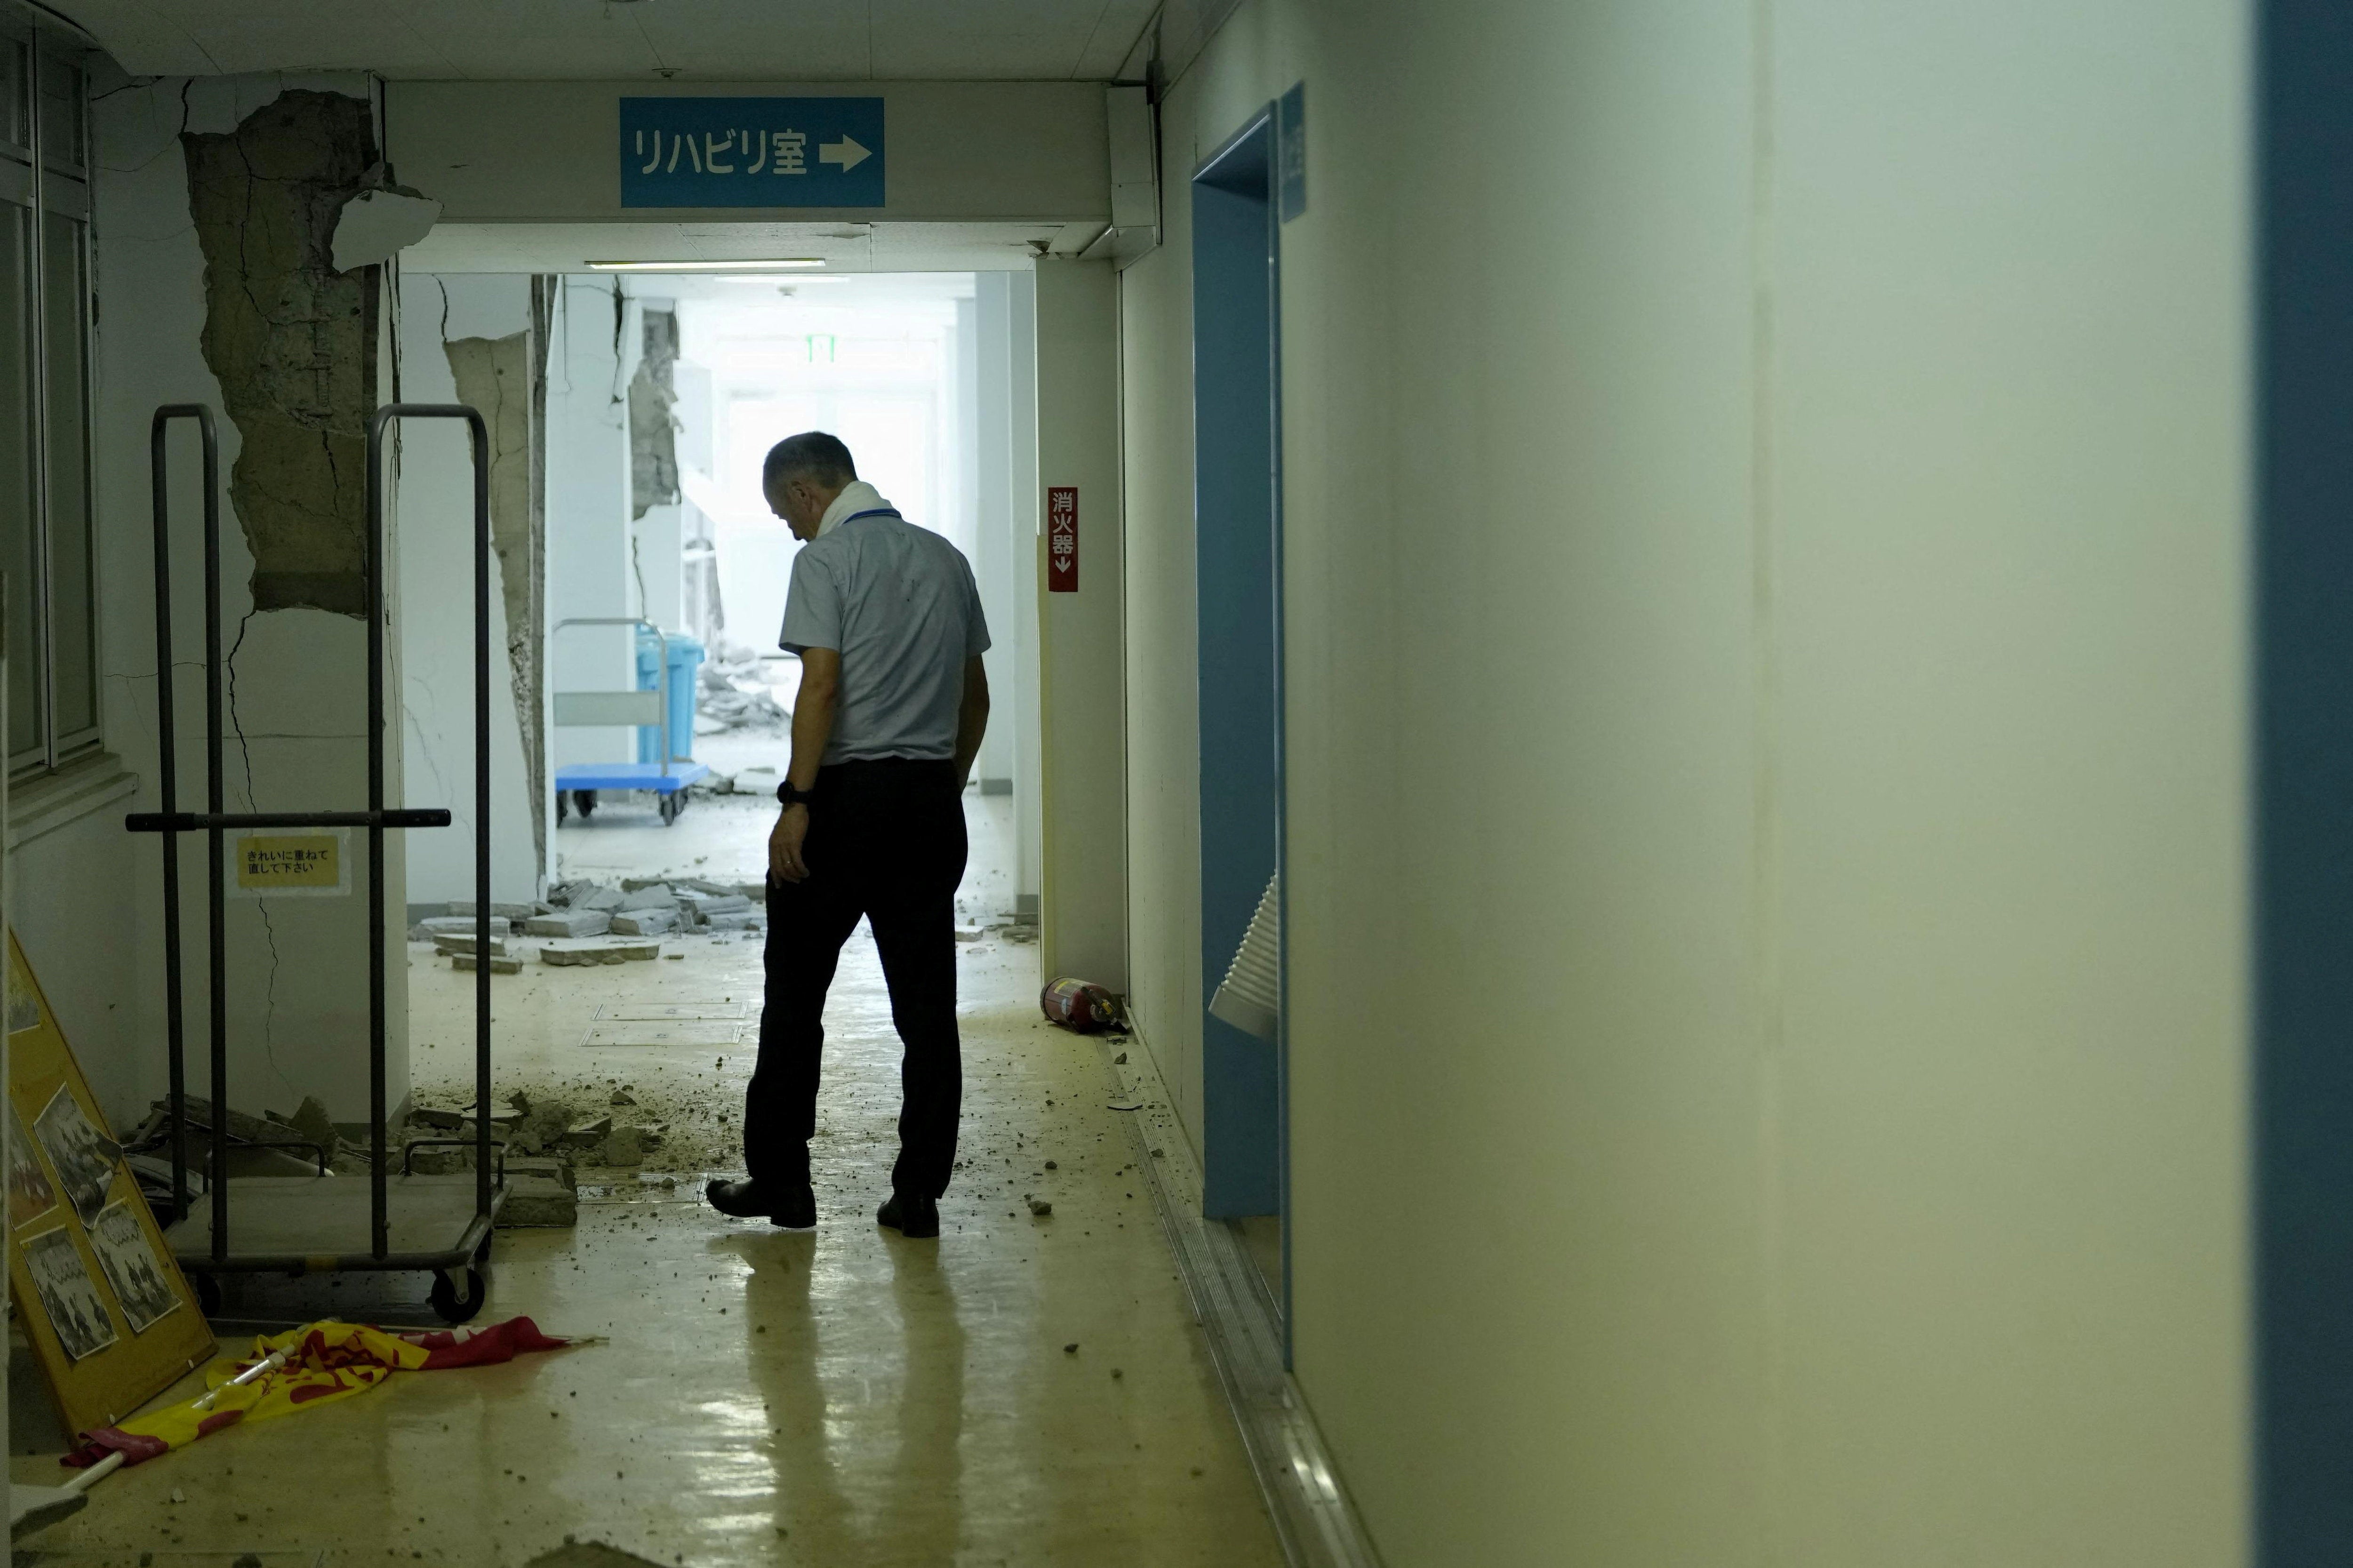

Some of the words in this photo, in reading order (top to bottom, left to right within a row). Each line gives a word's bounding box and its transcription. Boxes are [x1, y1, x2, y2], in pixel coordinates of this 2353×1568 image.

[636, 128, 807, 174] リハビリ室
[1053, 492, 1073, 554] 消火器
[247, 849, 328, 861] きれいに重ねて
[248, 863, 313, 874] 直して下さい
